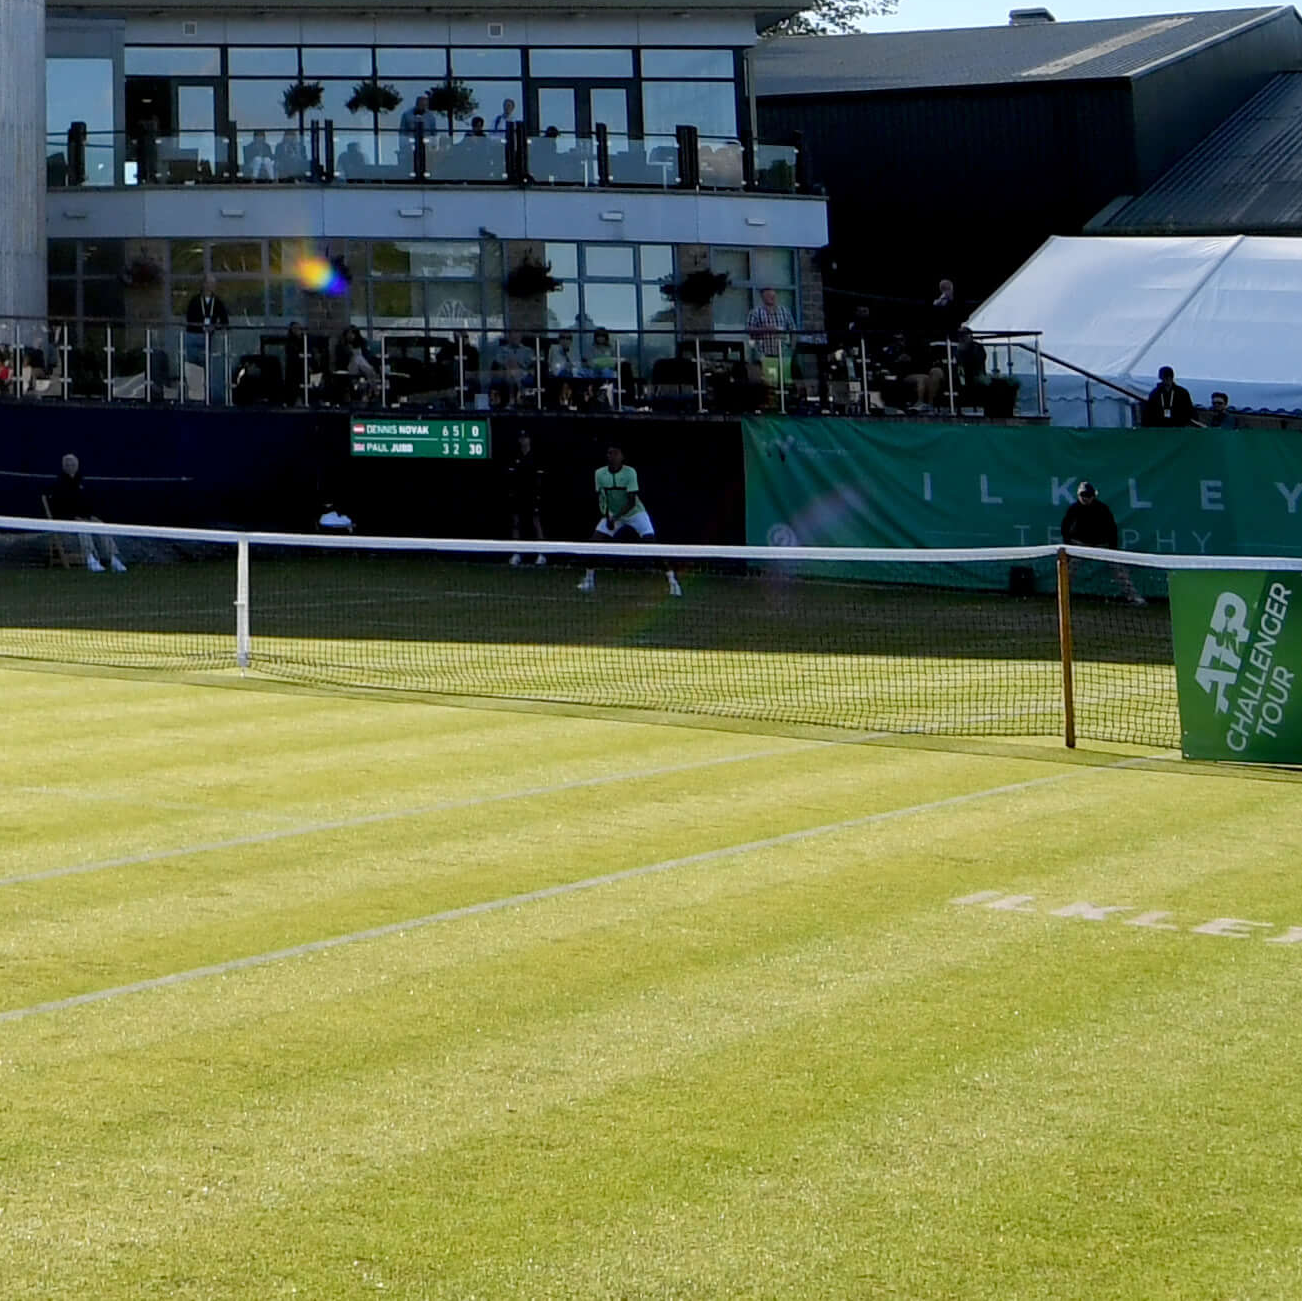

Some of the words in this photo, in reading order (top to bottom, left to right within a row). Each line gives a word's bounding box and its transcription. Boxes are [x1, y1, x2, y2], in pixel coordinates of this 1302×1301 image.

[366, 425, 397, 435] DENNIS
[398, 425, 430, 435] NOVAK
[442, 426, 449, 436] 6
[453, 426, 459, 436] 5
[471, 426, 479, 437] 0
[367, 443, 389, 452] PAUL
[442, 444, 450, 455] 3
[453, 444, 459, 455] 2
[469, 444, 483, 455] 30
[922, 472, 1302, 514] ILKLEY
[1195, 591, 1250, 715] ATP
[1227, 582, 1292, 752] CHALLENGER
[1256, 665, 1295, 739] TOUR
